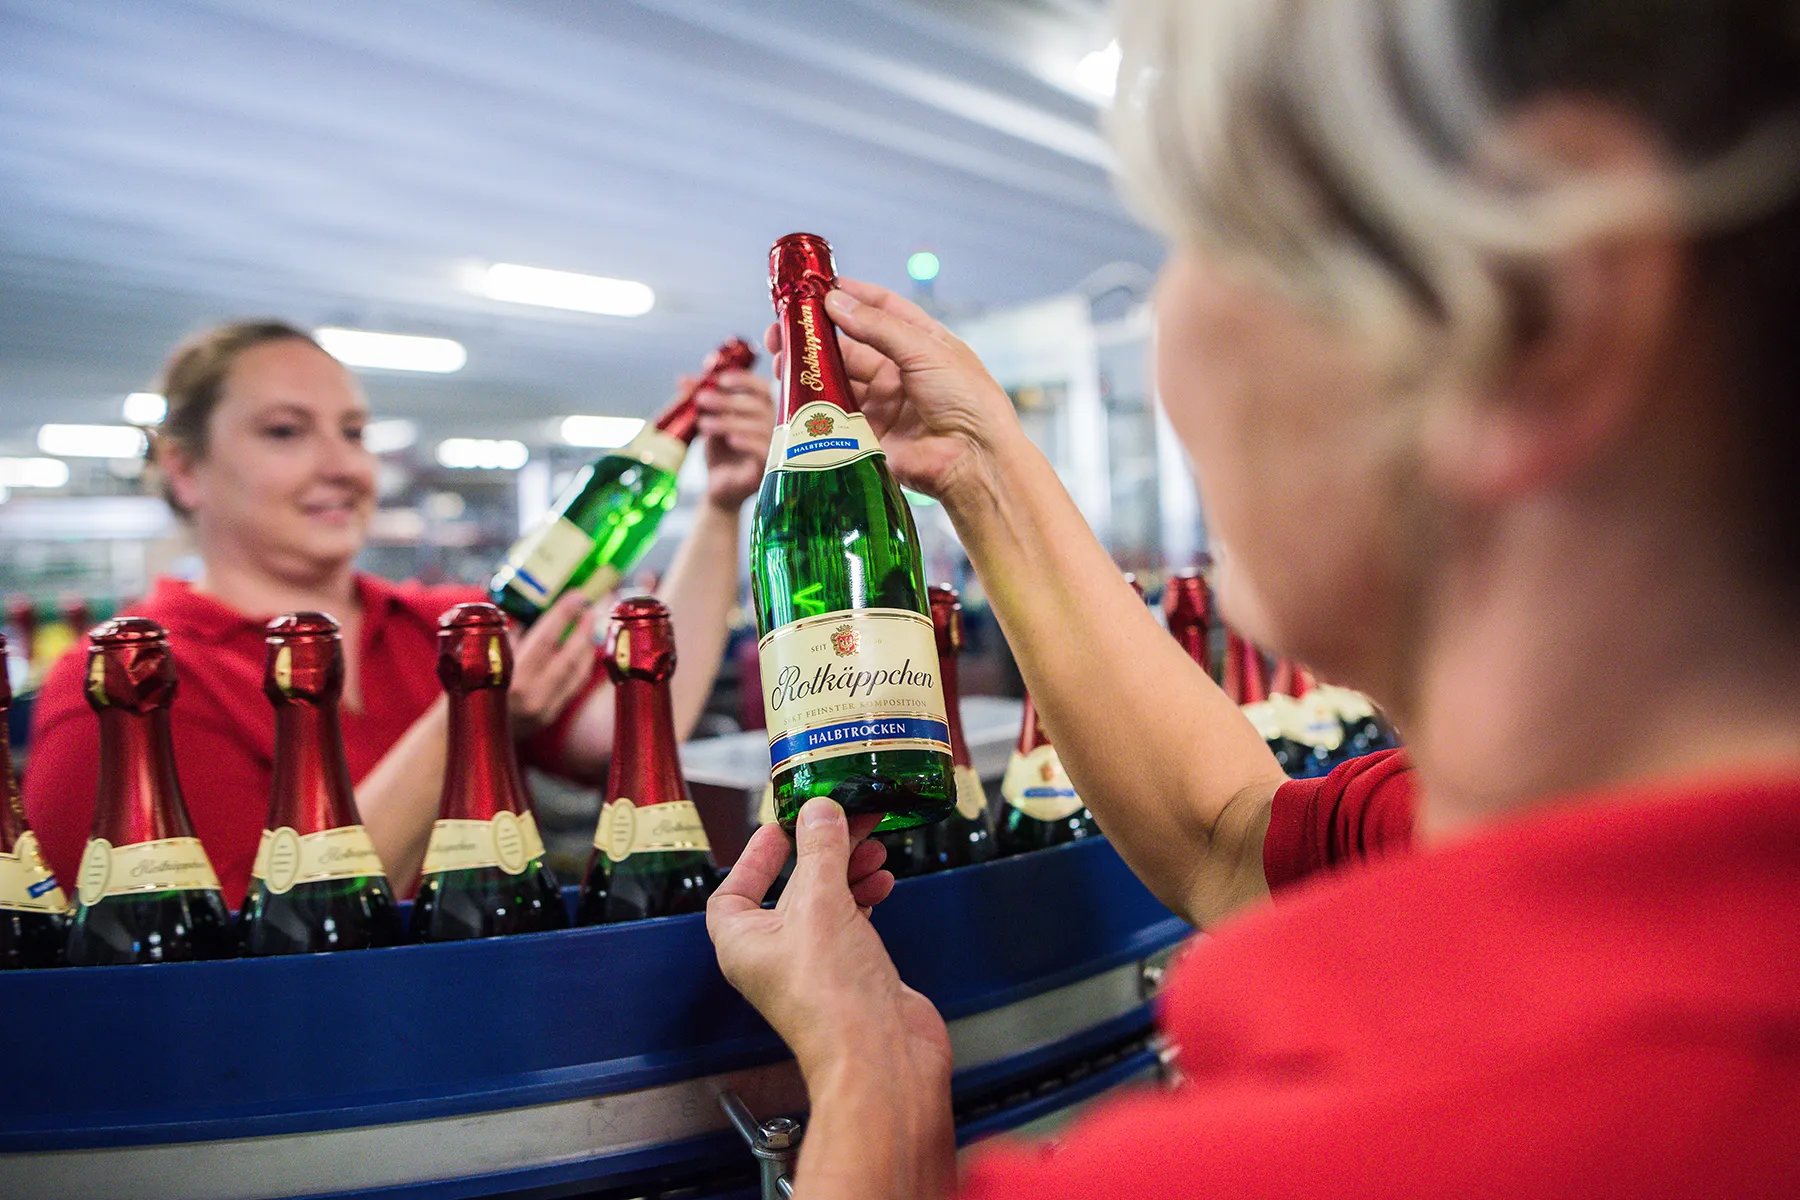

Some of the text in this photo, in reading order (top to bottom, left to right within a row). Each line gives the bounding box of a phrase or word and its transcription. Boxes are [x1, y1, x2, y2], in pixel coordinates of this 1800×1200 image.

[797, 304, 824, 391] Rotkäppchen
[793, 440, 851, 454] HALBTROCKEN
[810, 643, 827, 653] SEIT
[771, 658, 934, 711] Rotkäppchen
[783, 698, 927, 726] SKT FEINSTER KOMPOSITION
[808, 723, 906, 745] HALBTROCKEN
